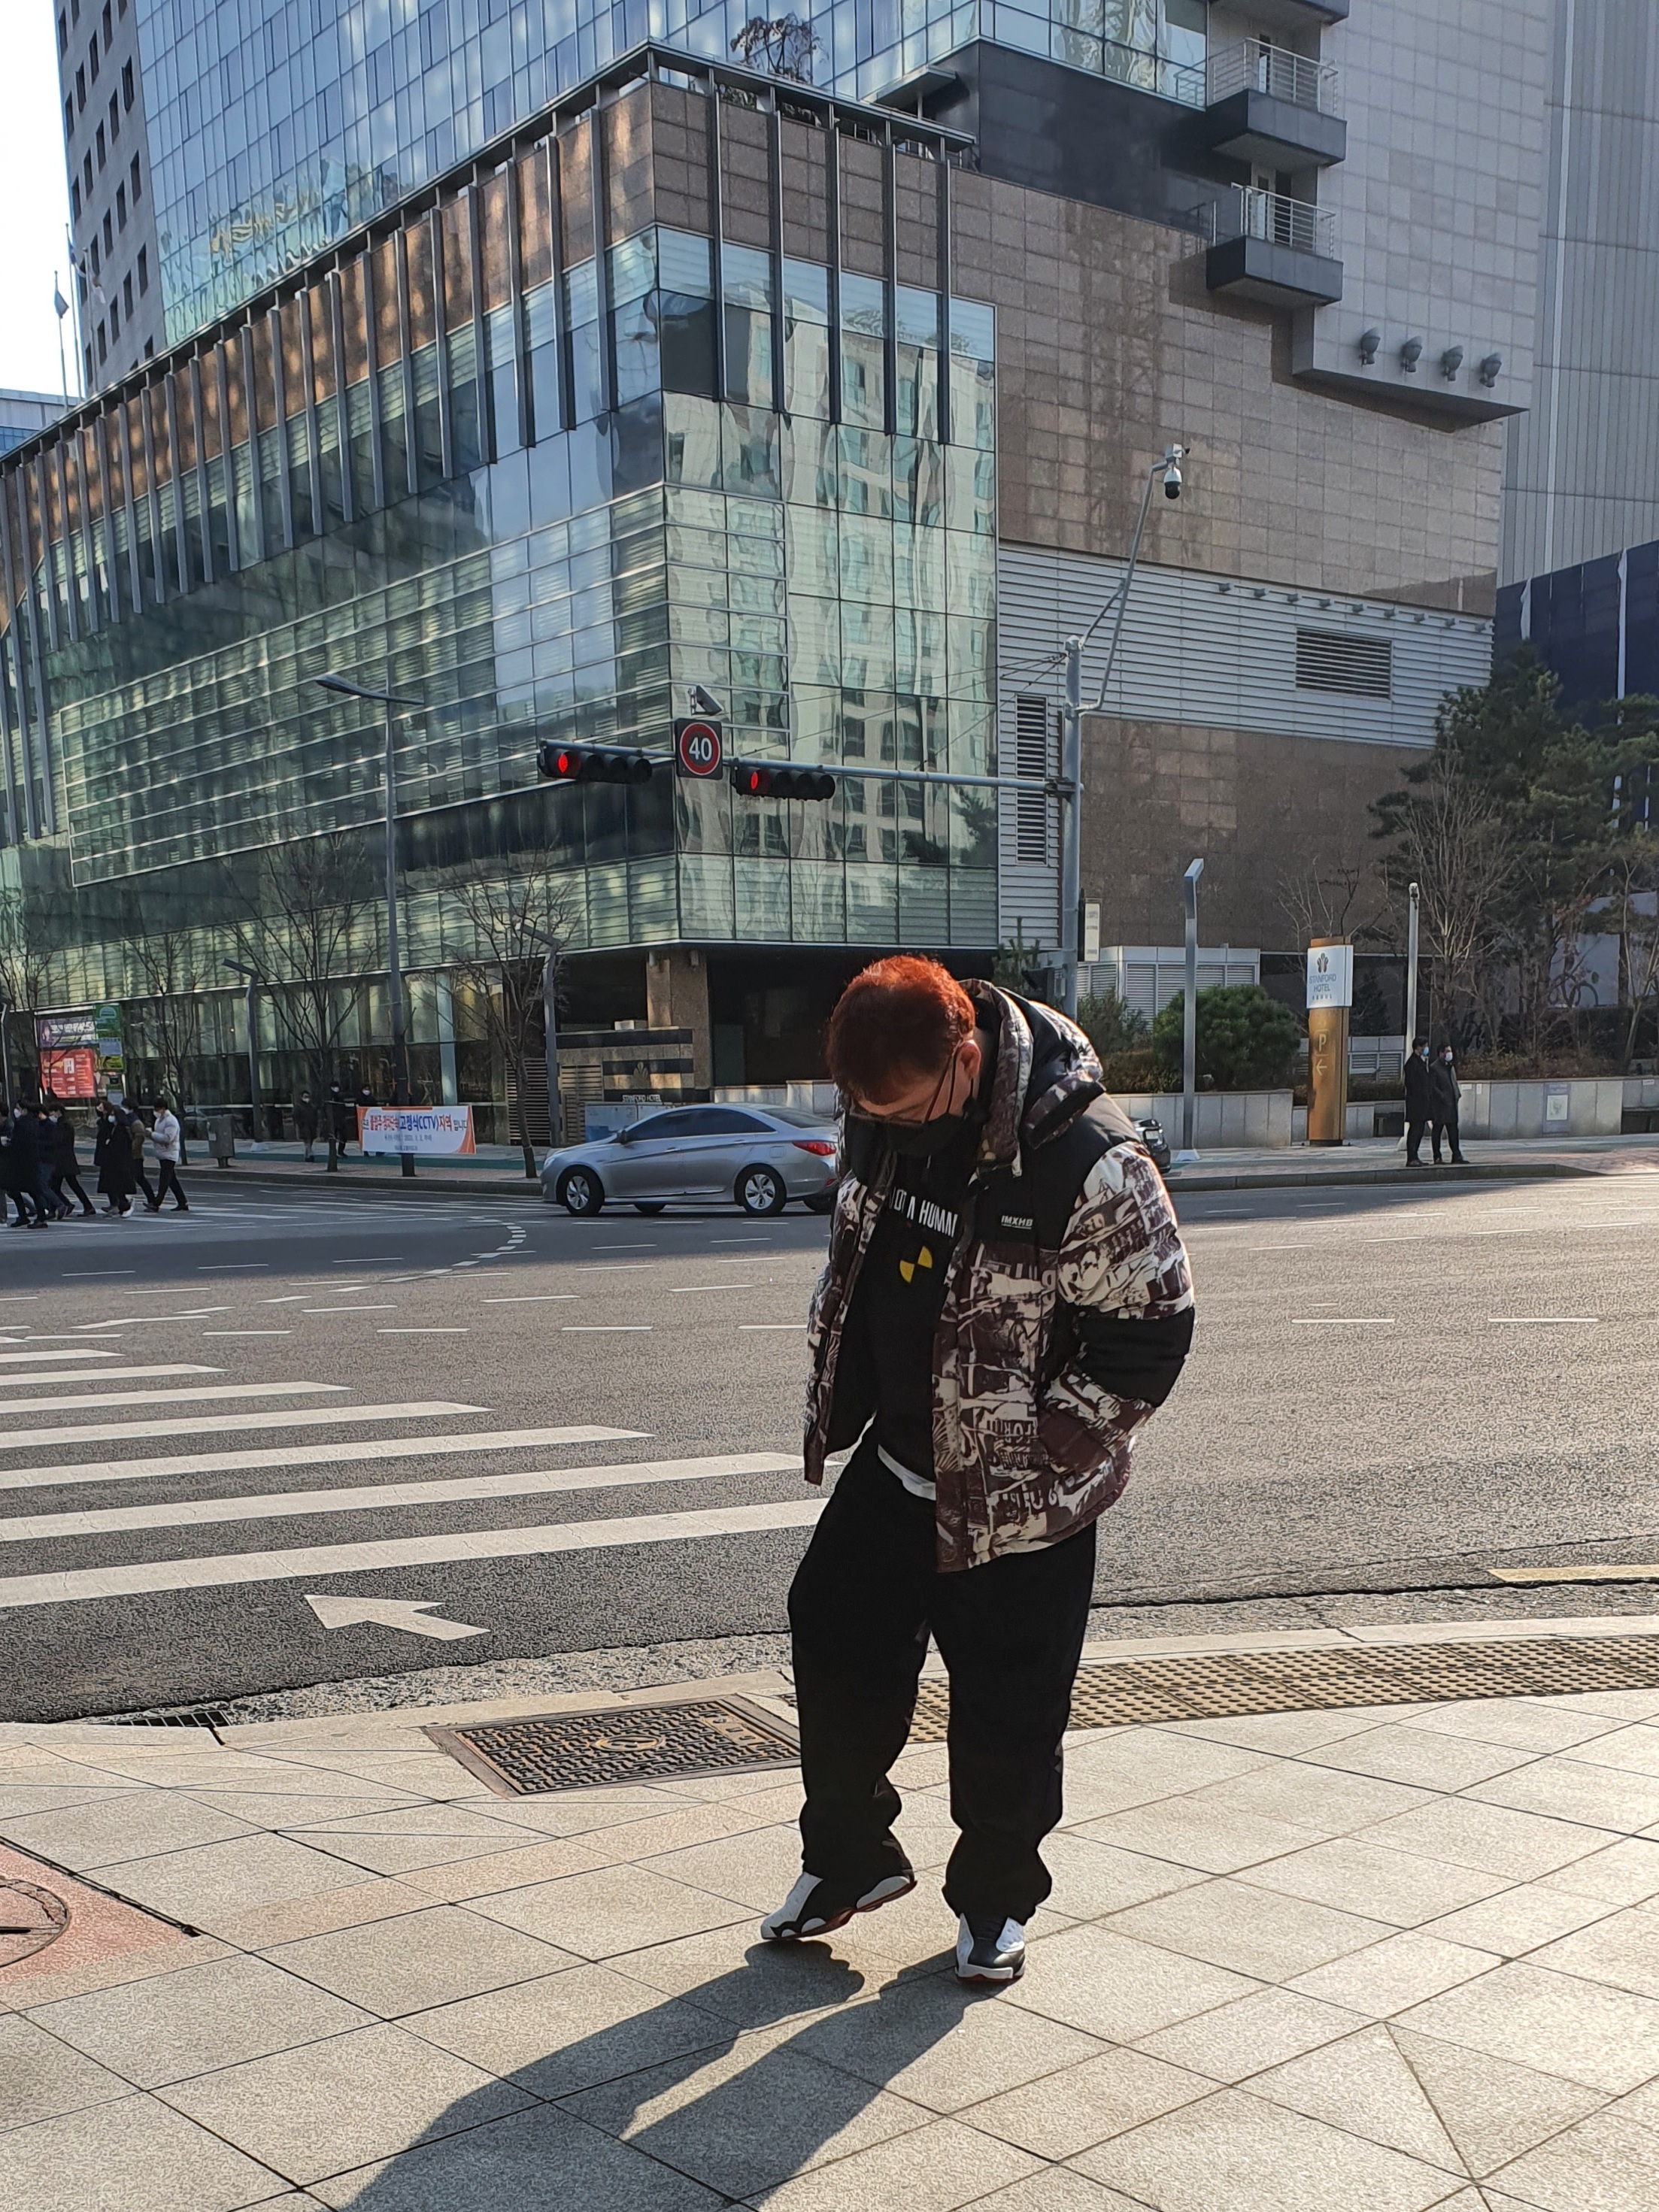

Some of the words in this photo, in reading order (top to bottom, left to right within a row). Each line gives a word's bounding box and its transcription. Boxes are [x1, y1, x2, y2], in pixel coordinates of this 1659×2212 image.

[689, 737, 712, 762] 40
[1309, 974, 1337, 984] STANFORD
[1313, 983, 1330, 992] HOTEL
[906, 1195, 916, 1220] A
